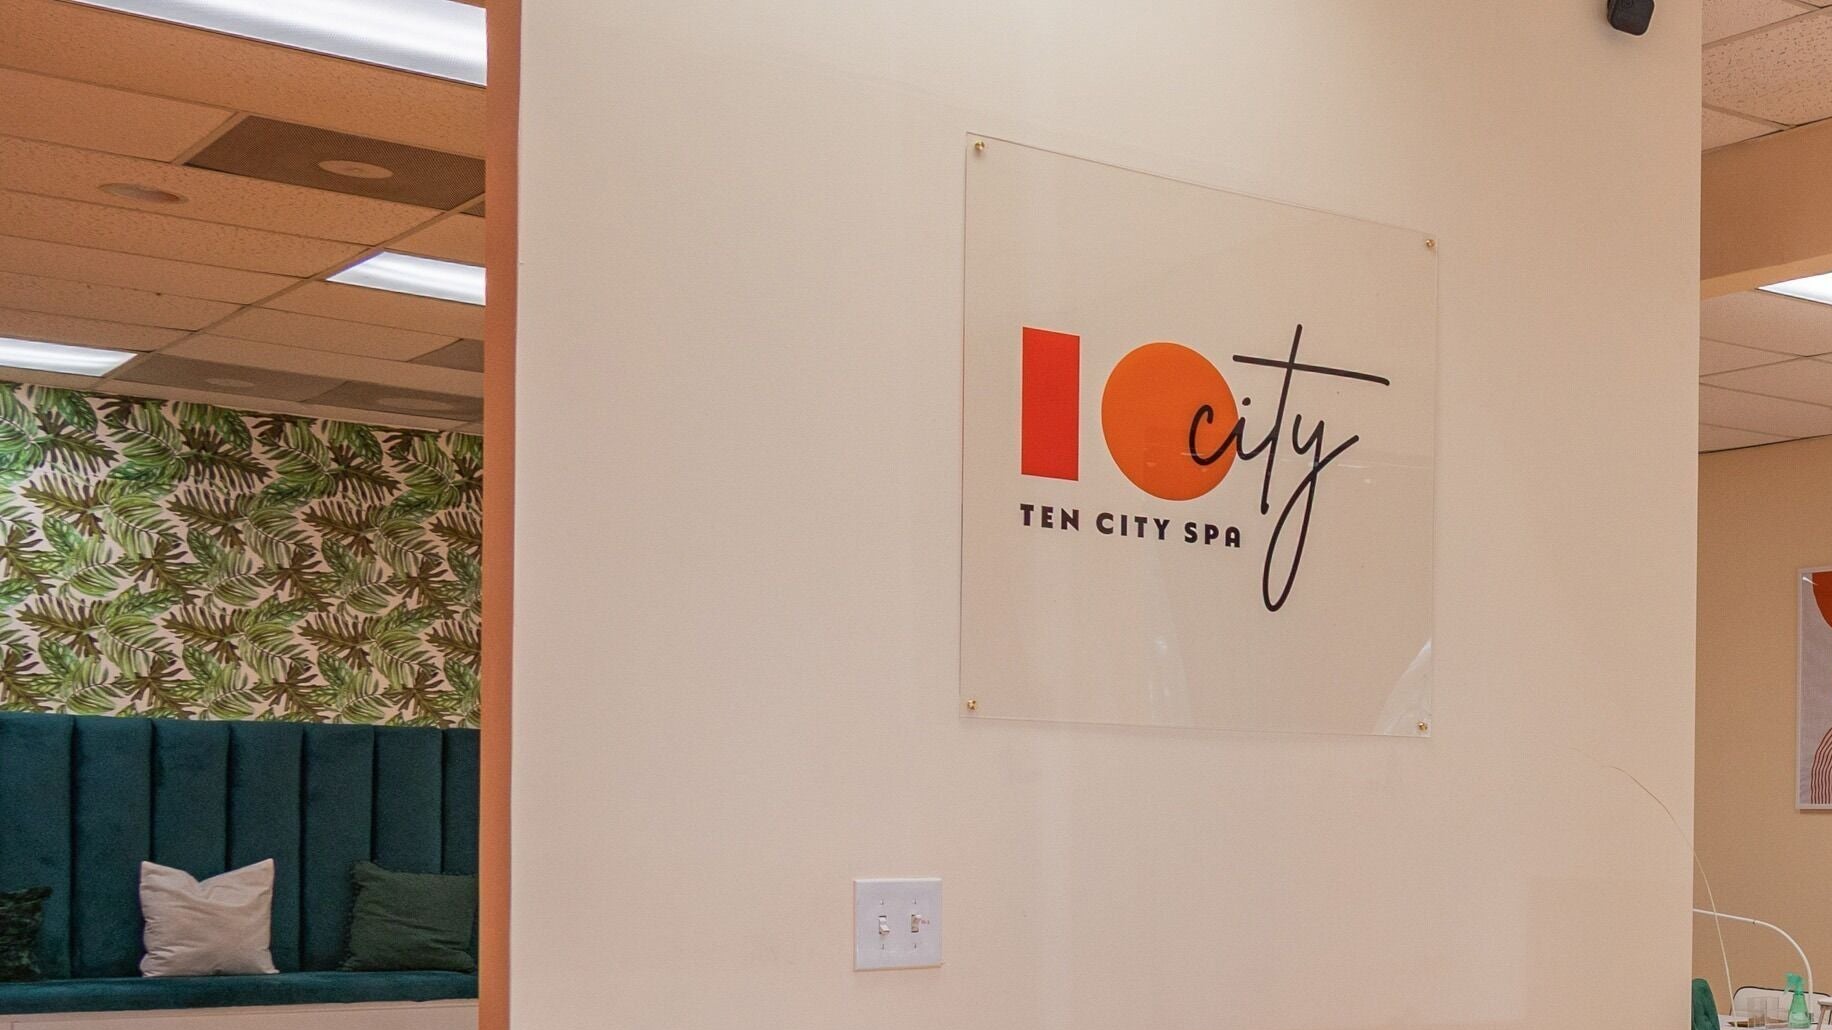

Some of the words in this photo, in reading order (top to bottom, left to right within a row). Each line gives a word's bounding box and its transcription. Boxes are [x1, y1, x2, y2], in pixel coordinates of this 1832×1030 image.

[1020, 503, 1079, 531] TEN
[1096, 512, 1170, 540] CITY
[1184, 521, 1241, 548] SPA
[1188, 324, 1390, 612] city
